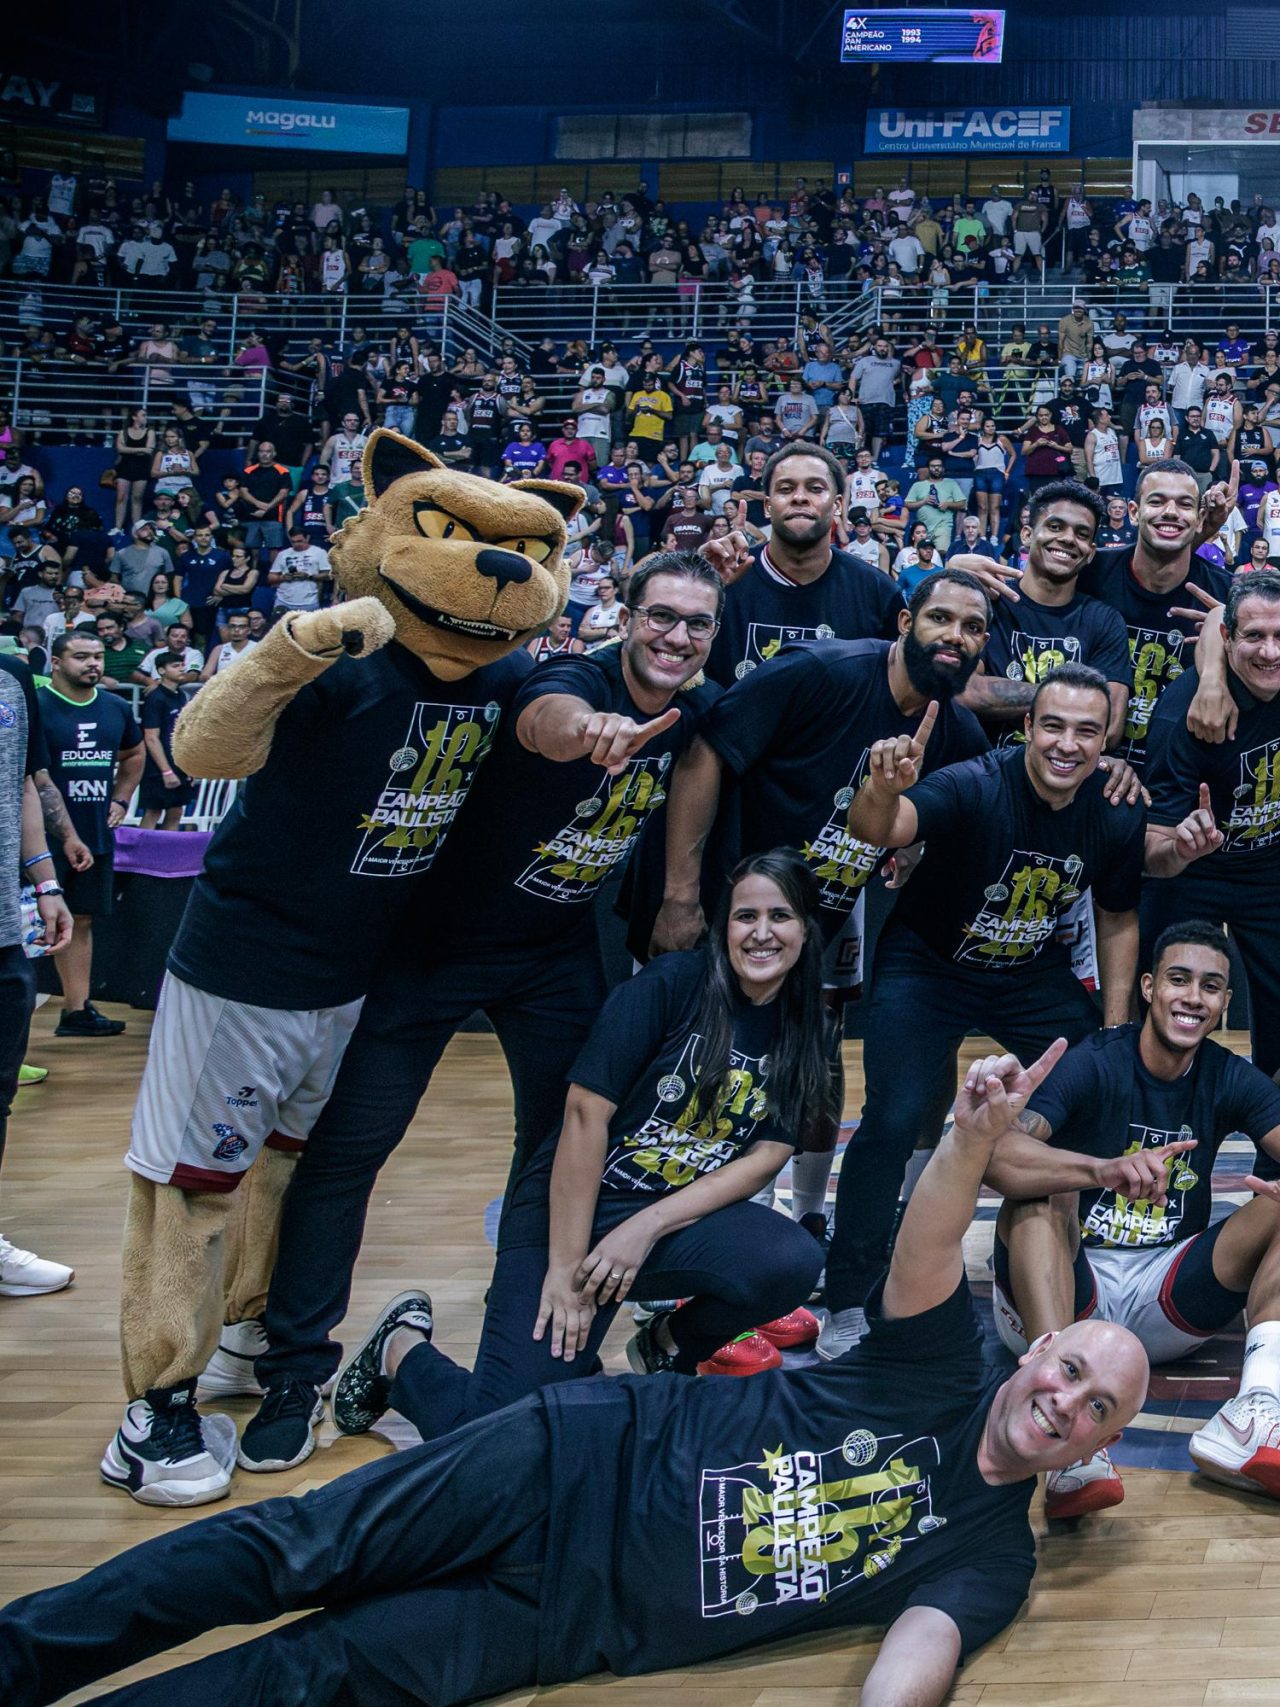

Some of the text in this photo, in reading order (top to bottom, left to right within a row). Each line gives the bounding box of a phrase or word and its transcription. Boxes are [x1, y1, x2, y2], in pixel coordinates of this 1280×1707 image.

[845, 17, 868, 29] 4X
[845, 30, 885, 38] CAMPEÃO
[0, 74, 63, 108] AY
[879, 110, 1062, 138] Uni-FACEF
[879, 142, 909, 150] Centro
[970, 140, 1015, 150] Municipal
[1017, 140, 1030, 149] de
[62, 750, 113, 760] EDUCARE
[68, 780, 108, 797] KNN
[810, 839, 878, 873] PAULIS
[614, 1167, 632, 1181] MAIOR
[718, 1482, 726, 1508] MAIOR
[718, 1508, 727, 1554] VENCEDOR
[772, 1454, 799, 1606] PAULISTA
[795, 1450, 827, 1602] CAMPEÃO
[719, 1567, 729, 1605] HISTÓRIA
